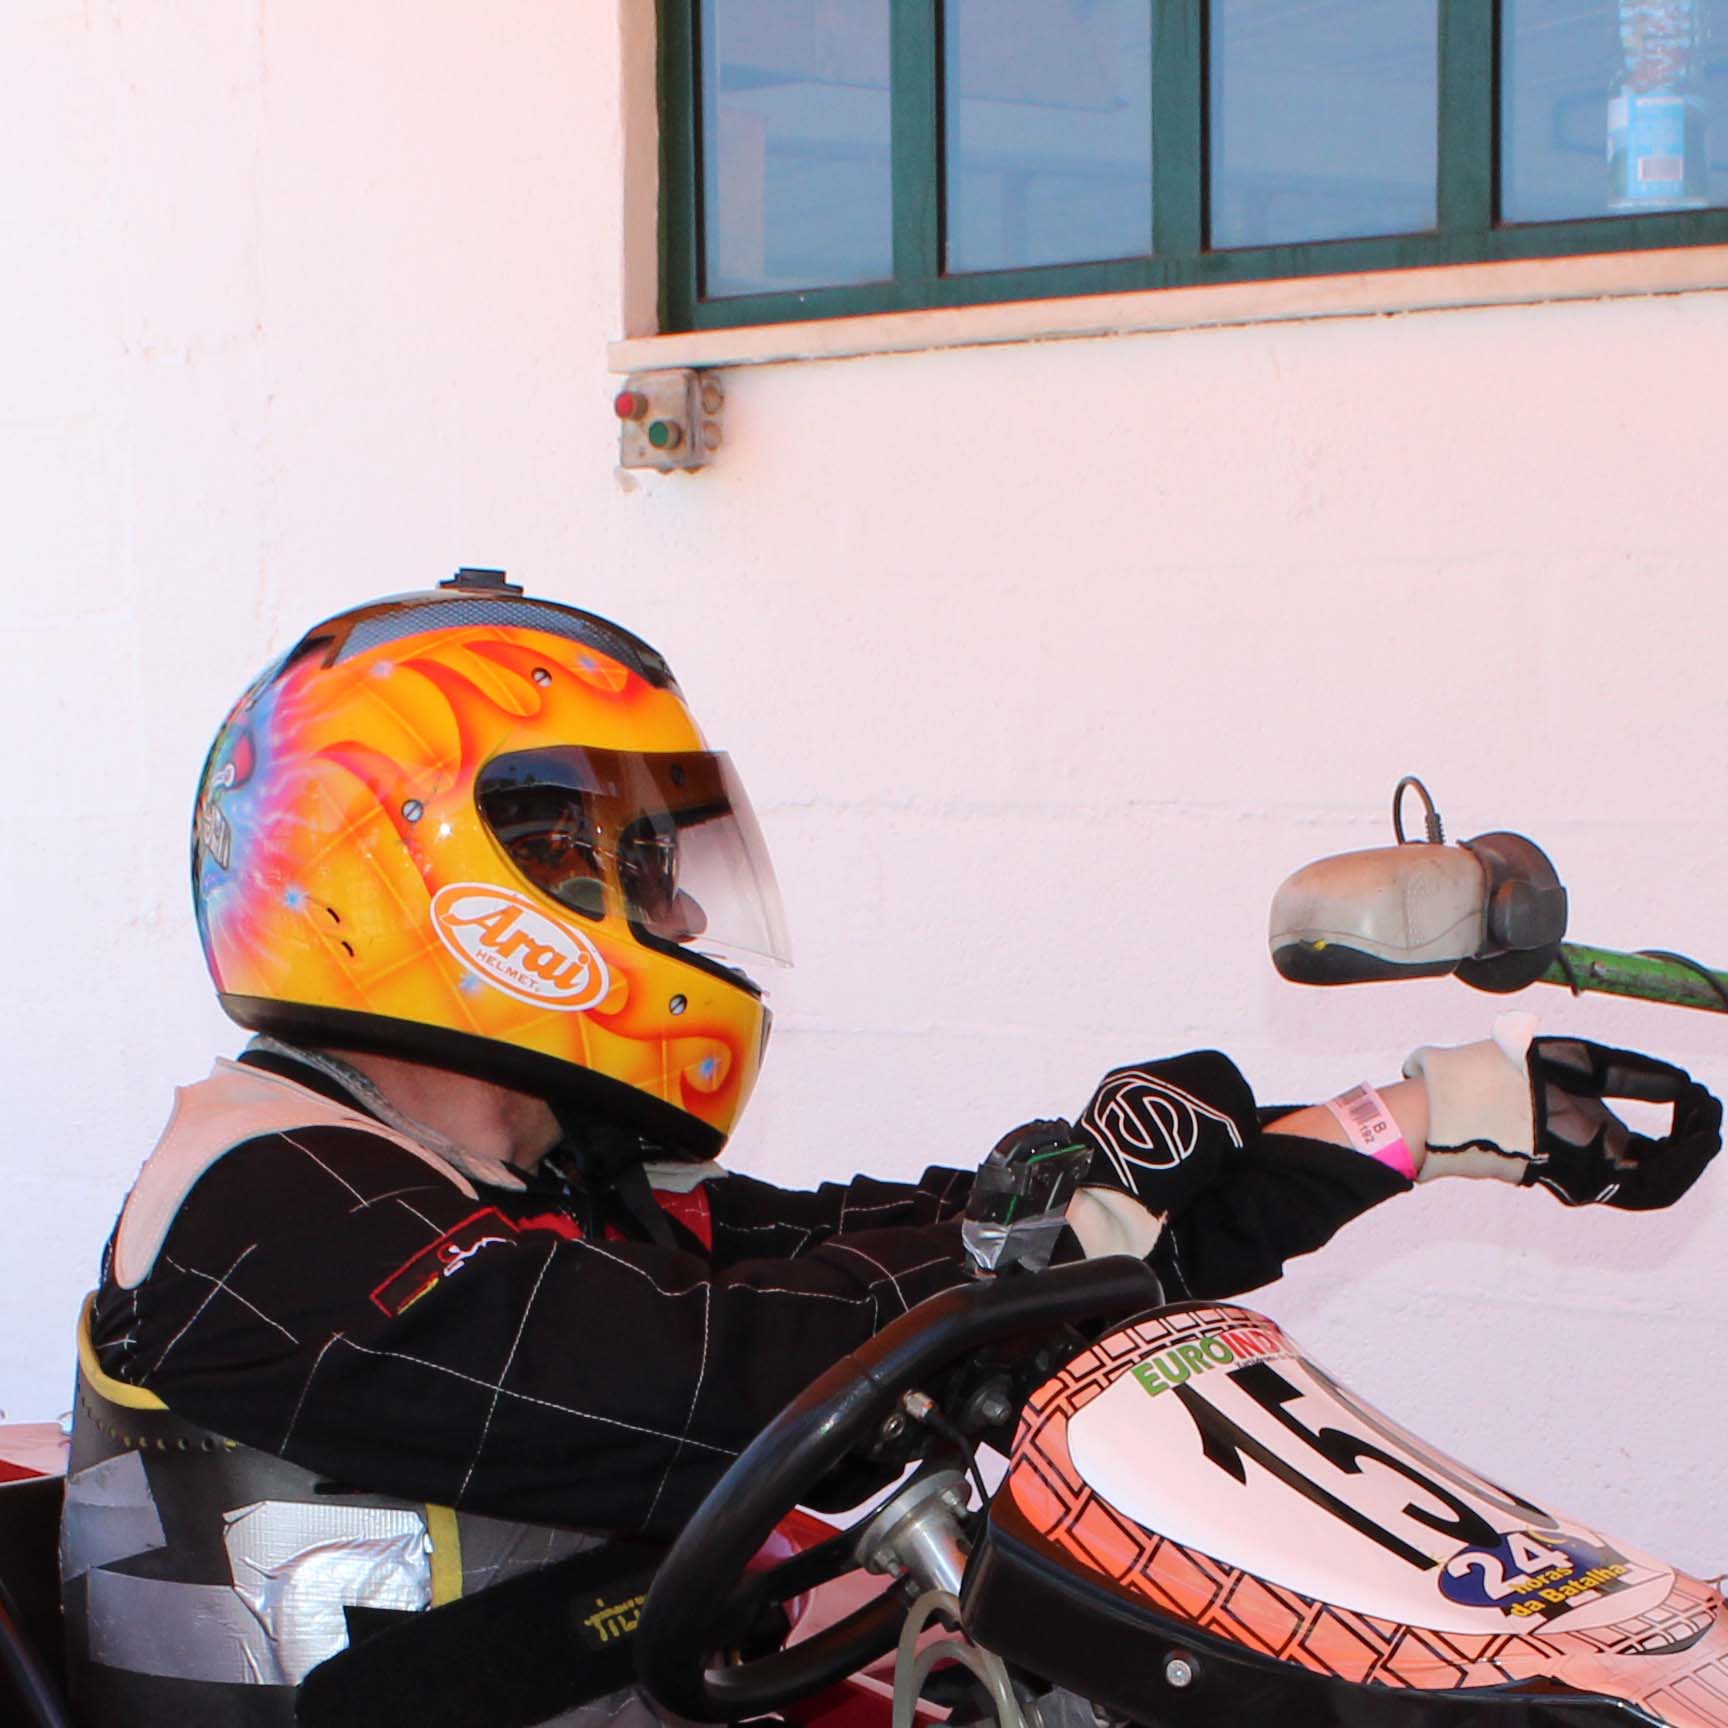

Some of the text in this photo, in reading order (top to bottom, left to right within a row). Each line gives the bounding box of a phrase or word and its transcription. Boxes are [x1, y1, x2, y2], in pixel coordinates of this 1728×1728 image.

[440, 903, 591, 991] Arai
[1447, 1532, 1575, 1601] 24
[1507, 1566, 1574, 1595] horas
[1510, 1563, 1629, 1618] da Batalha
